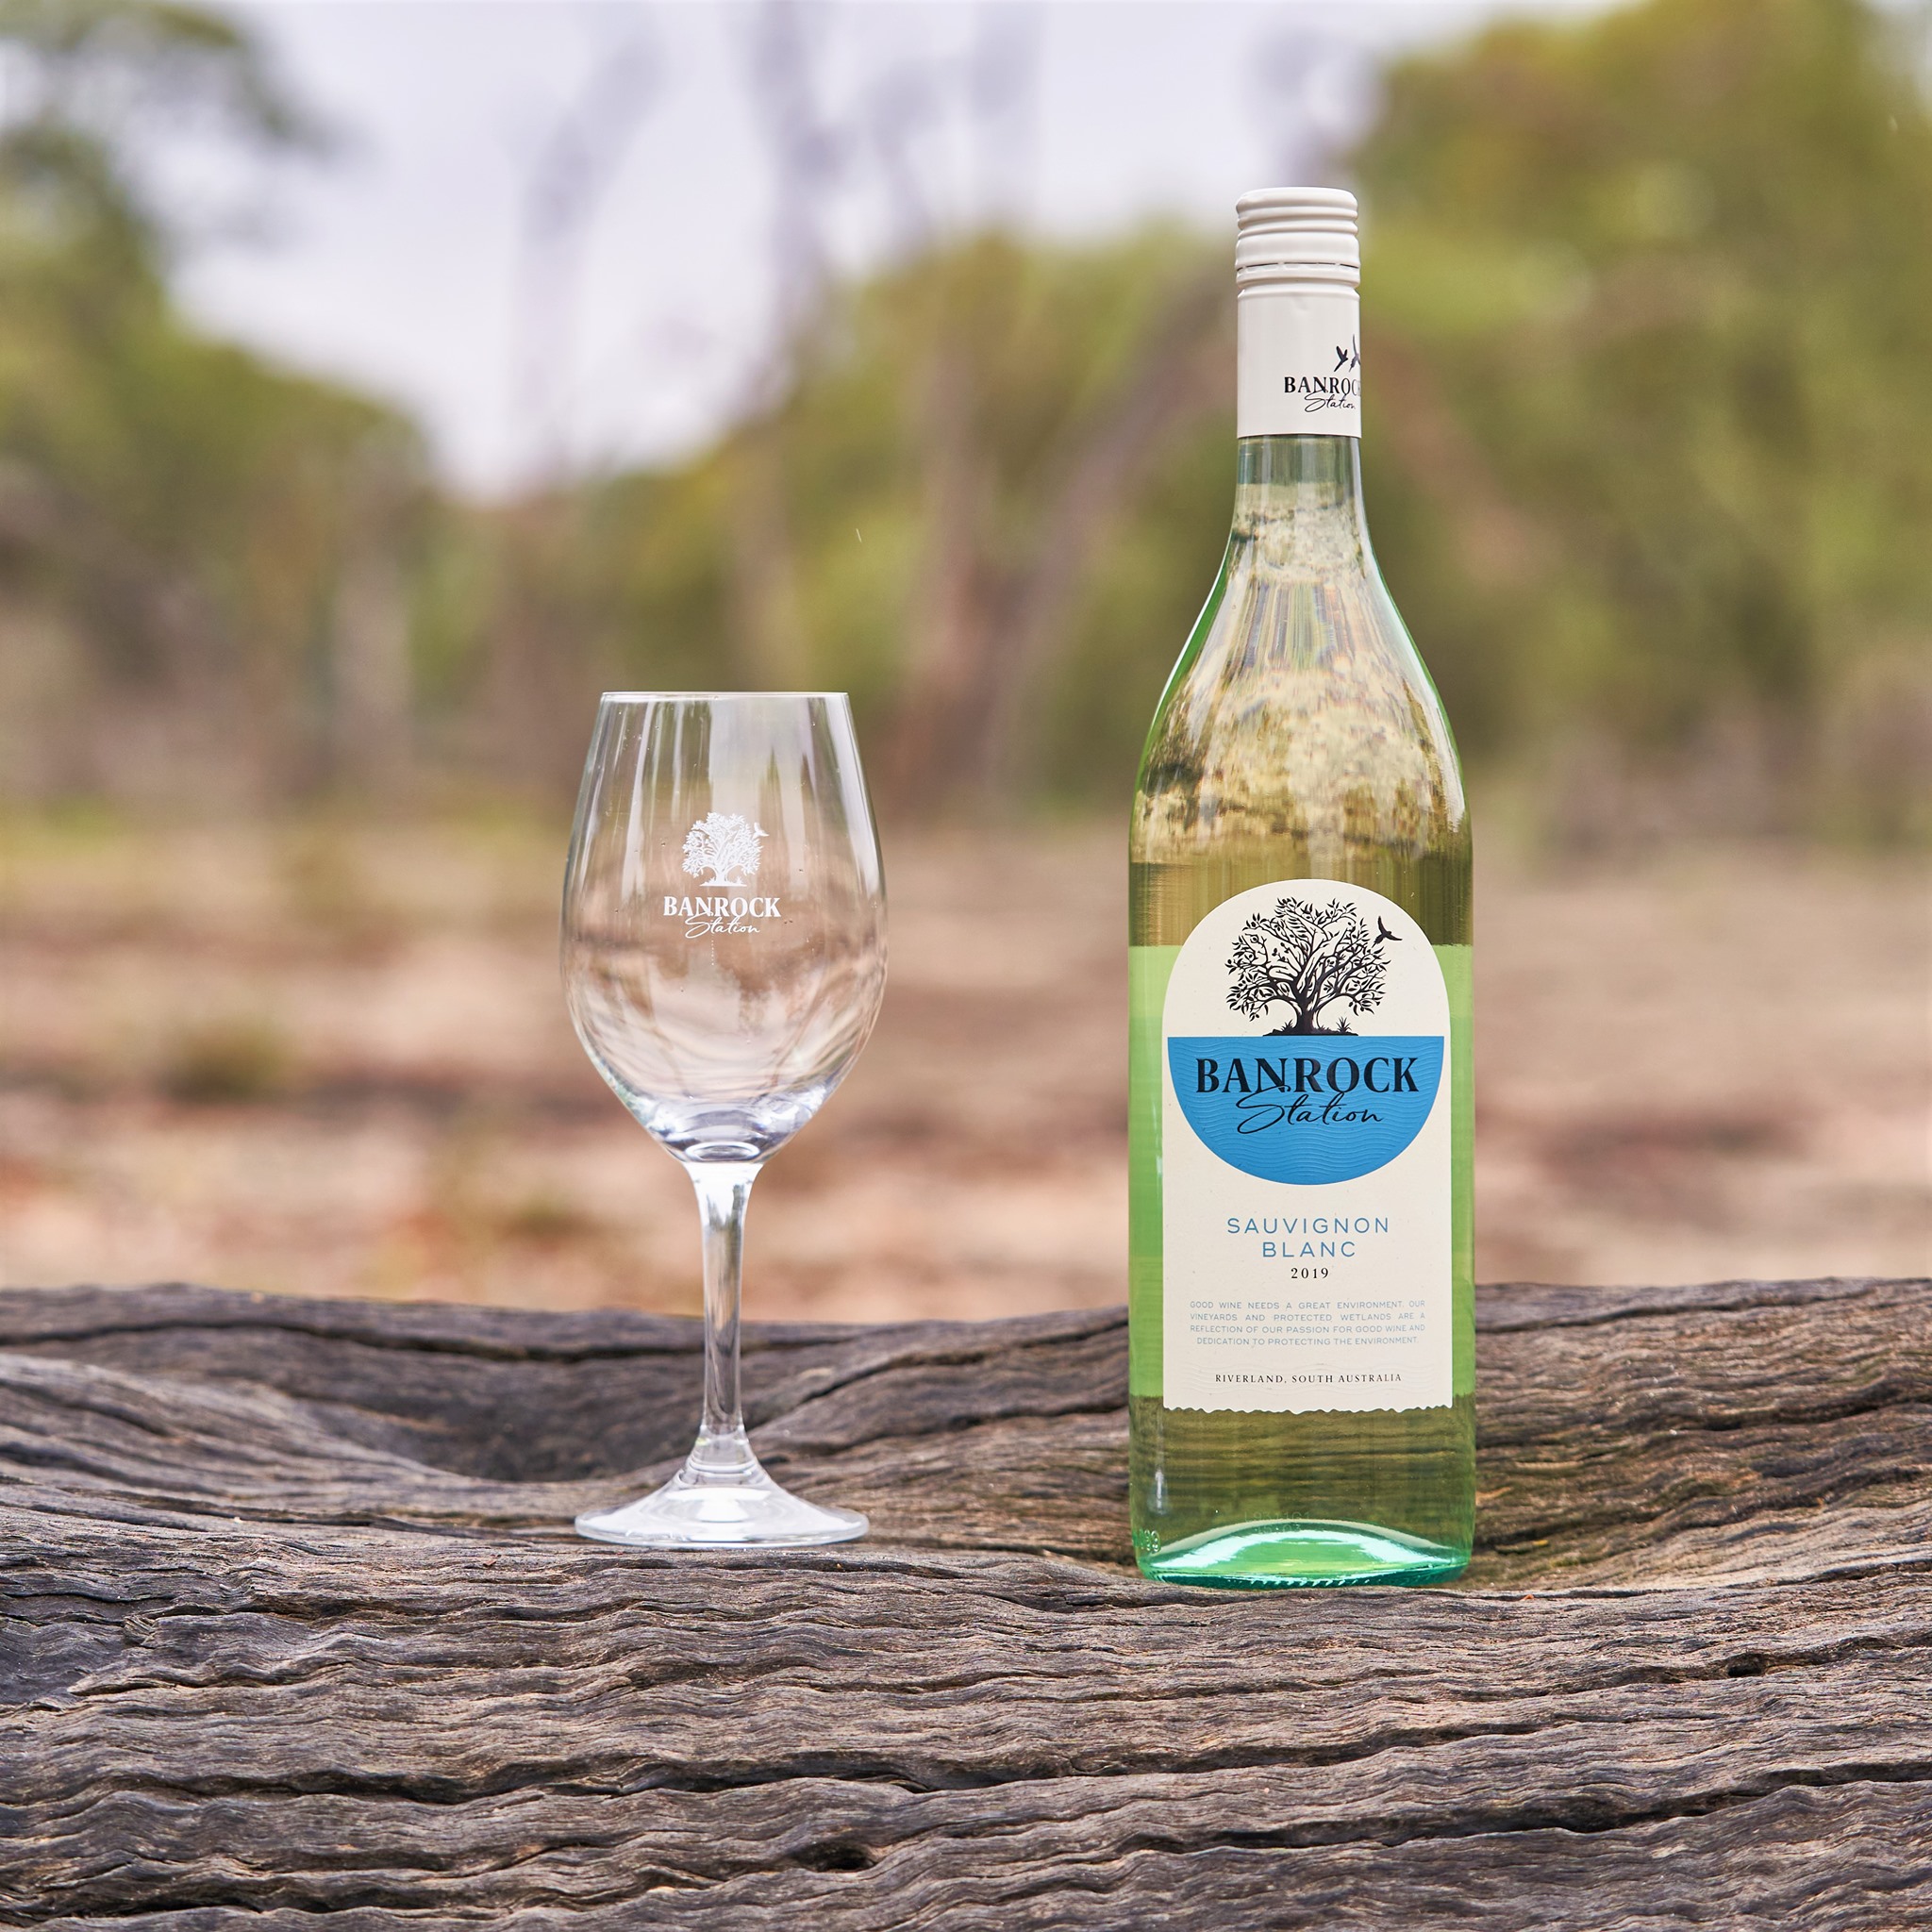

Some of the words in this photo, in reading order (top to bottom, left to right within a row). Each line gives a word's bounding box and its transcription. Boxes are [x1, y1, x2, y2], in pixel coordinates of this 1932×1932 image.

[1304, 389, 1357, 413] Station
[663, 896, 781, 918] BANROCK
[685, 911, 760, 939] Station
[1195, 1057, 1420, 1093] BANROCK
[1235, 1084, 1385, 1135] Station
[1226, 1217, 1389, 1234] SAUVIGNON
[1262, 1241, 1356, 1257] BLANC
[1291, 1267, 1329, 1279] 2019
[1190, 1313, 1238, 1322] VINEYARDS
[1341, 1313, 1391, 1322] WETLANDS
[1190, 1324, 1243, 1333] REFLECTION
[1286, 1325, 1330, 1334] PASSION
[1196, 1337, 1250, 1345] DEDICATION
[1215, 1374, 1287, 1384] RIVERLAND,
[1291, 1374, 1333, 1383] SOUTH
[1338, 1374, 1402, 1383] AUSTRALIA
